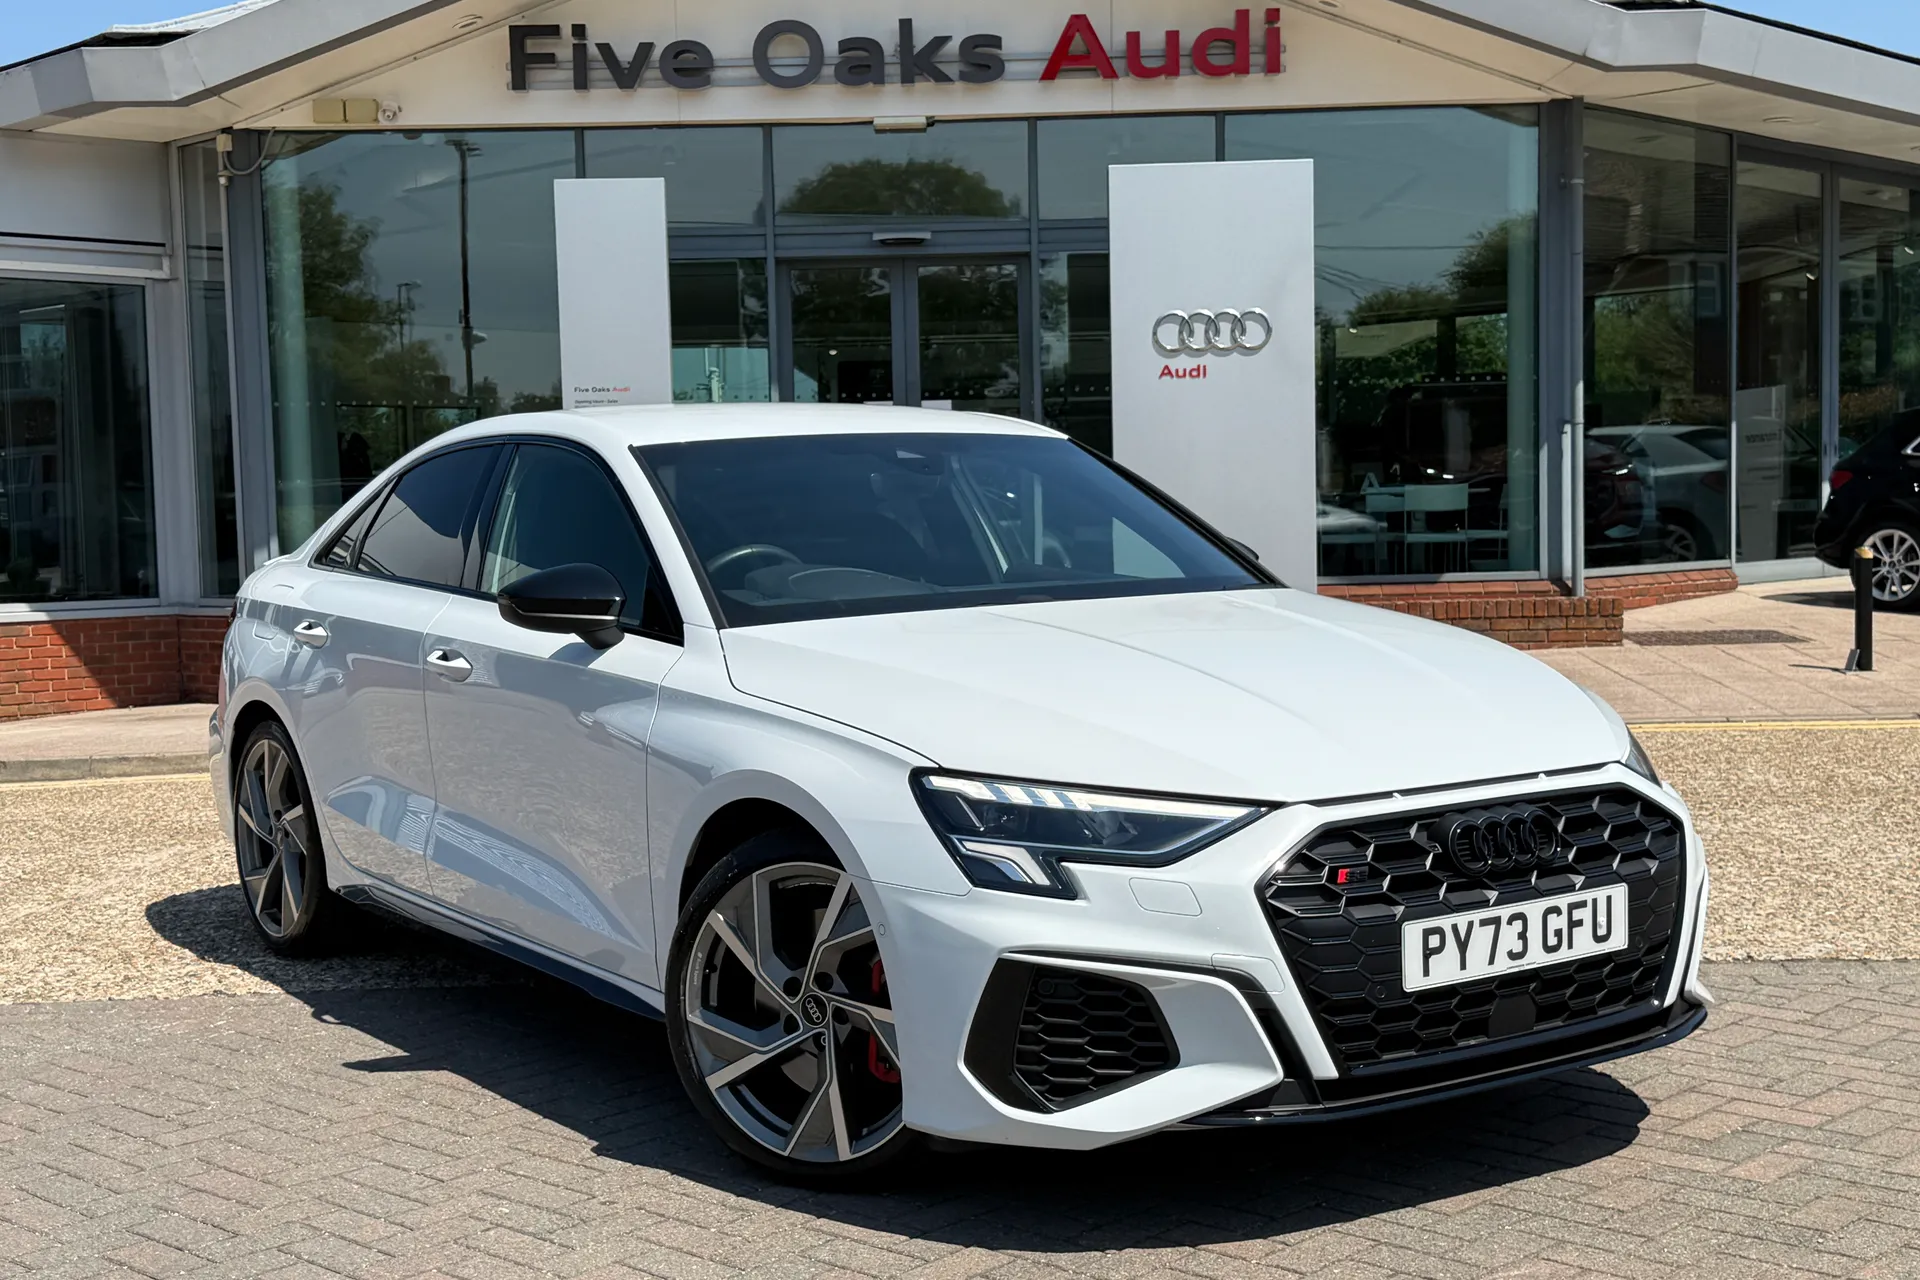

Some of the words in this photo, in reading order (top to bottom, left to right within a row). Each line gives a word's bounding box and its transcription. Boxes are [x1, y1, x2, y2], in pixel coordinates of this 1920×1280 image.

[508, 23, 714, 92] Five
[752, 18, 1006, 89] Oaks
[1039, 8, 1281, 82] Audi
[1158, 364, 1207, 379] Audi
[1422, 911, 1528, 978] PY73
[1541, 894, 1613, 955] GFU
